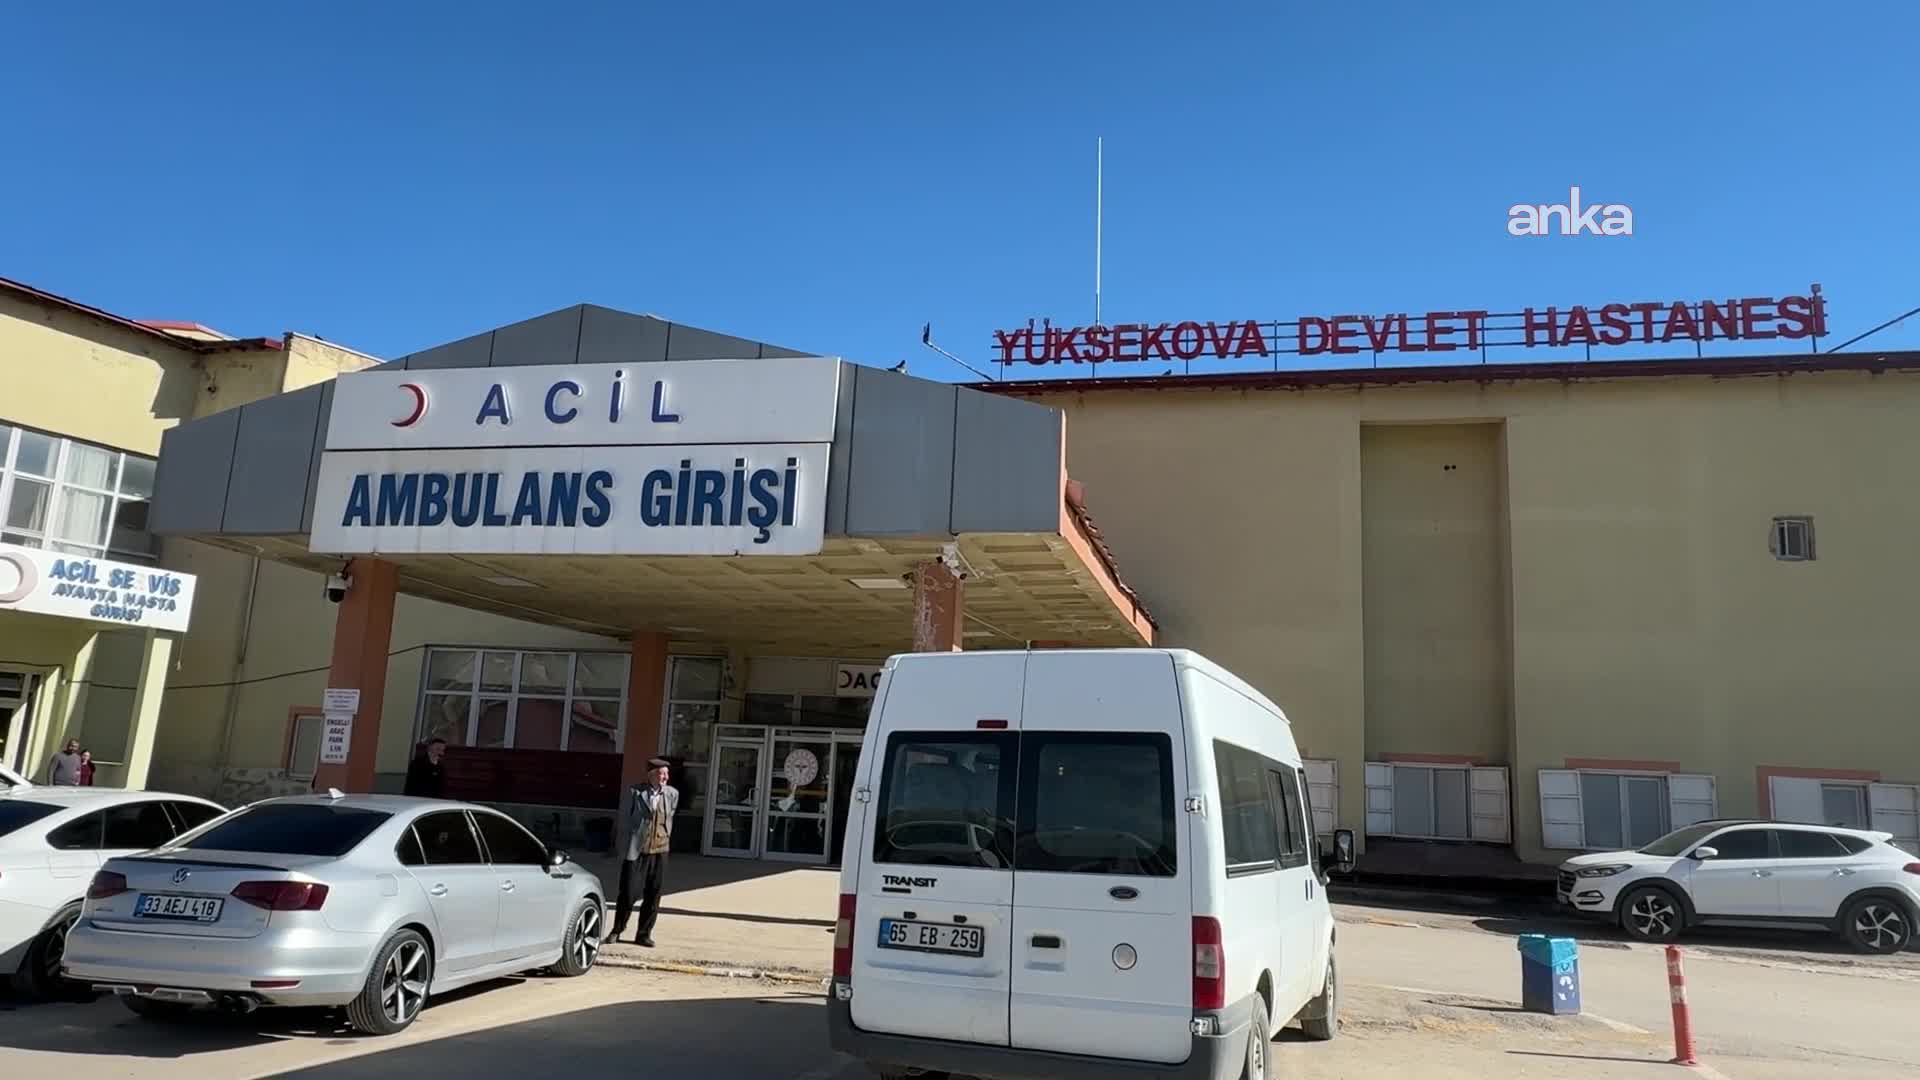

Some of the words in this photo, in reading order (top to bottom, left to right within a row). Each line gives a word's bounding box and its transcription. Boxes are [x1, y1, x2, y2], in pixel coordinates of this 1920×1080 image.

[997, 318, 1269, 366] YÜKSEKOVA
[1298, 310, 1488, 356] DEVLET
[1523, 284, 1828, 349] HASTANESİ
[476, 369, 682, 425] ACİL
[342, 469, 613, 528] AMBULANS
[639, 457, 801, 544] GİRİŞİ
[49, 559, 100, 584] ACİL
[52, 583, 118, 603] AYAKTA
[853, 671, 882, 690] AC
[882, 875, 937, 887] TRANSIT
[144, 897, 160, 912] 33
[163, 899, 188, 914] AEJ
[192, 901, 216, 916] 418
[889, 924, 908, 943] 65
[919, 926, 938, 945] EB
[950, 929, 979, 949] 259
